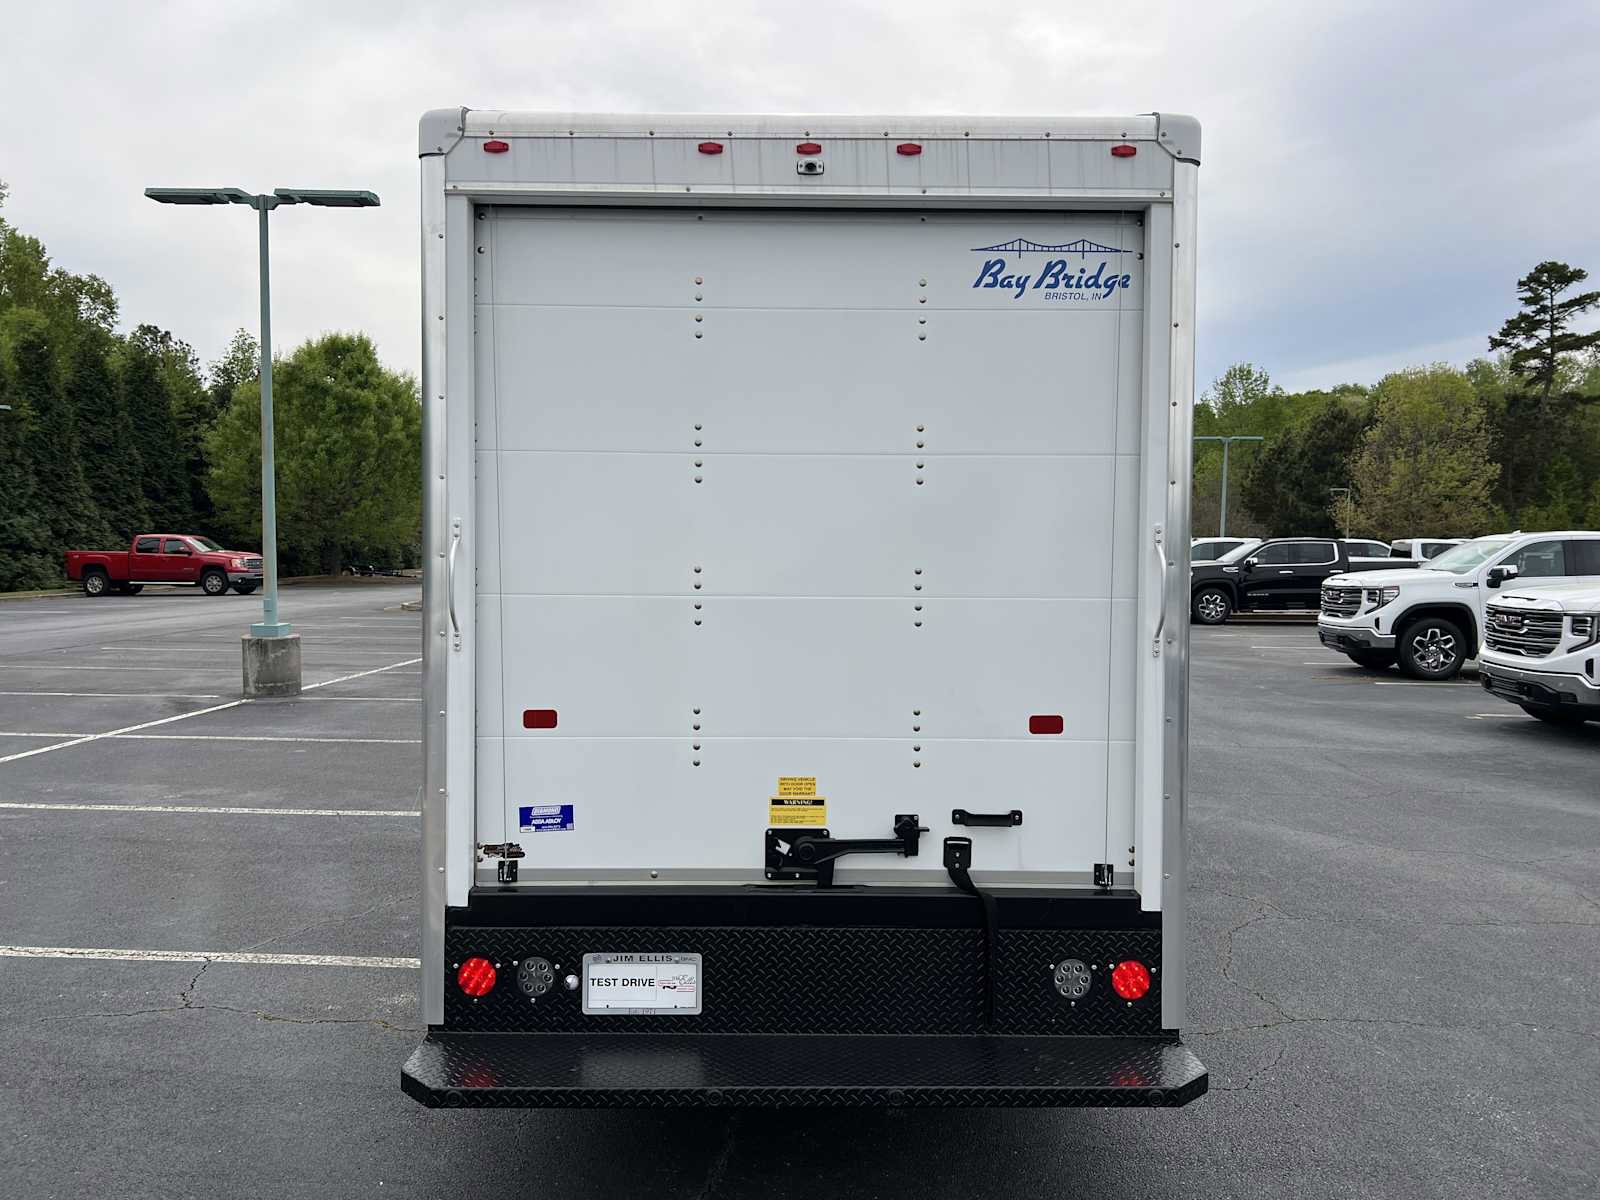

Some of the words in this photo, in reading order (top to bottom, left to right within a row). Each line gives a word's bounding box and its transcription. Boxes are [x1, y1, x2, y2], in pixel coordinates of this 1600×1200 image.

[972, 258, 1031, 299] Bay
[1032, 259, 1131, 299] Bridge
[1044, 292, 1089, 301] BRISTOL,
[1091, 292, 1102, 300] IN
[590, 978, 618, 987] TEST
[621, 978, 655, 987] DRIVE
